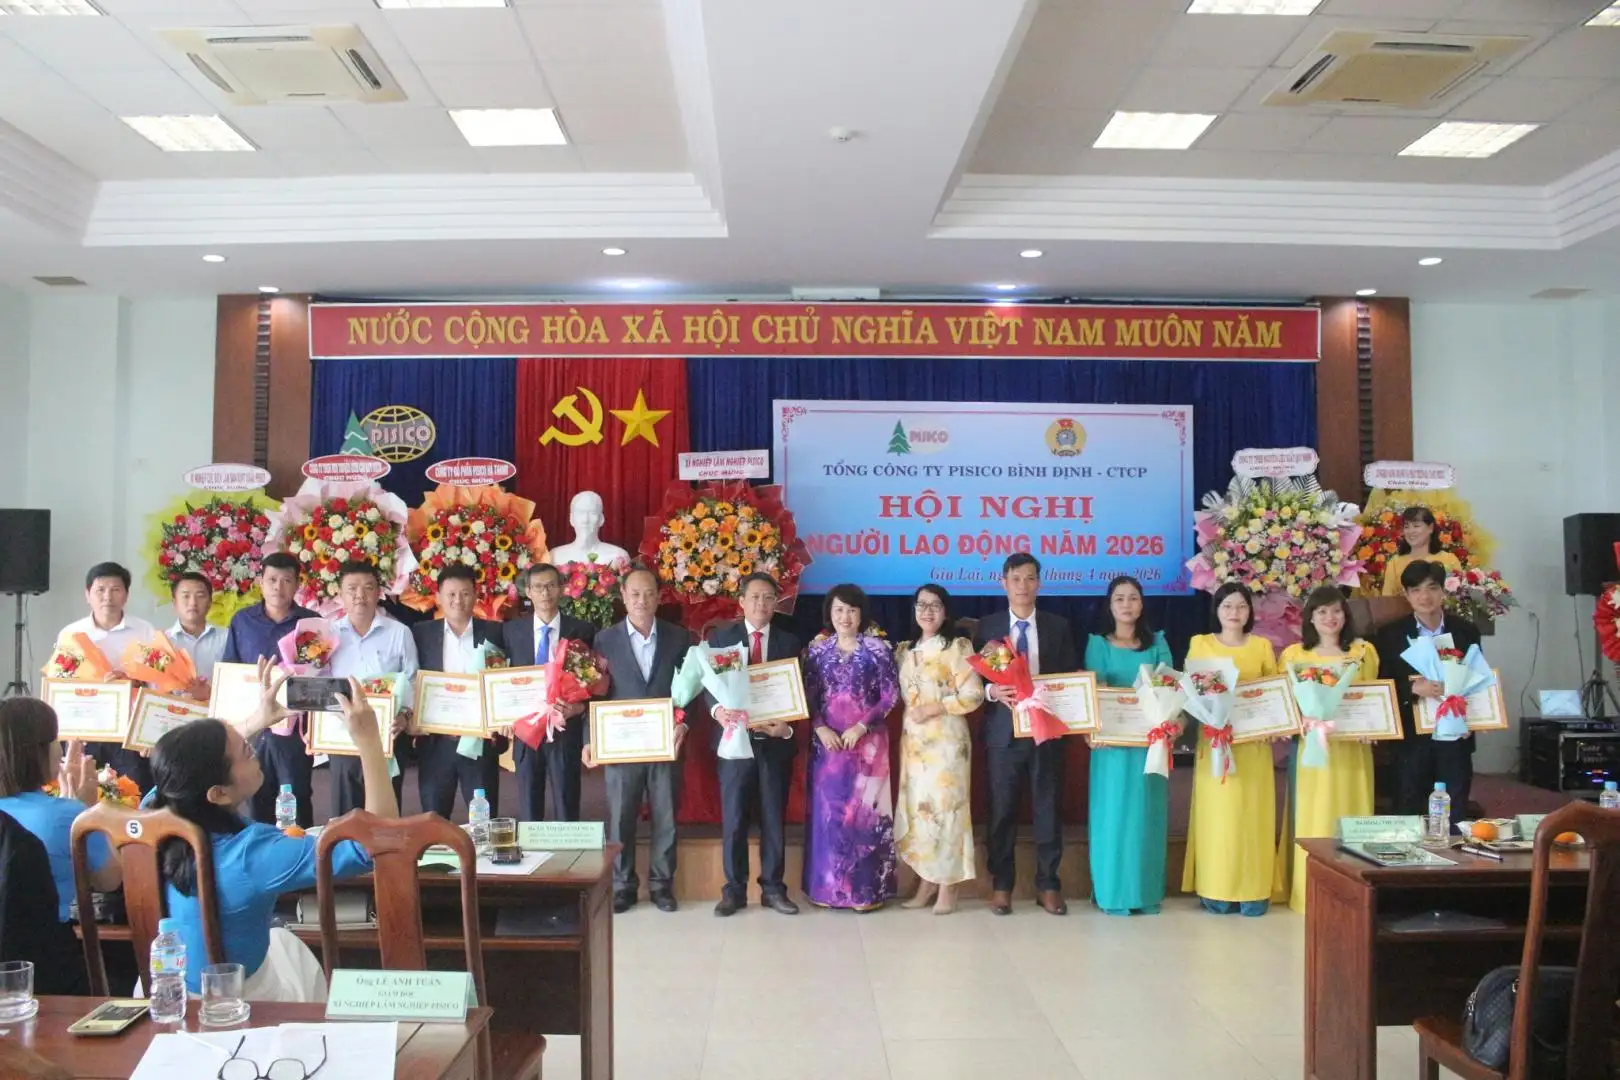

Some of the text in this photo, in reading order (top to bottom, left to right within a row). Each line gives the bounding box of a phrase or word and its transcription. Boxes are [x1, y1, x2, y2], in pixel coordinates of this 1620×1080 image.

[348, 306, 1283, 349] NƯỚC CỘNG HÒA XÃ HỘI CHỦ NGHĨA VIỆT NAM MUÔN NĂM
[371, 425, 431, 444] PISICO
[823, 460, 870, 477] TỔNG
[873, 463, 918, 477] CÔNG
[923, 465, 943, 477] TY
[948, 465, 1002, 477] PISICO
[1008, 463, 1046, 478] BÌNH
[1052, 466, 1092, 480] ĐỊNH
[1106, 466, 1147, 479] CTCP
[879, 489, 1094, 524] HỘI NGHỊ
[806, 528, 1164, 561] NGƯỜI LAO ĐỘNG NĂM 2026
[130, 822, 138, 834] 5
